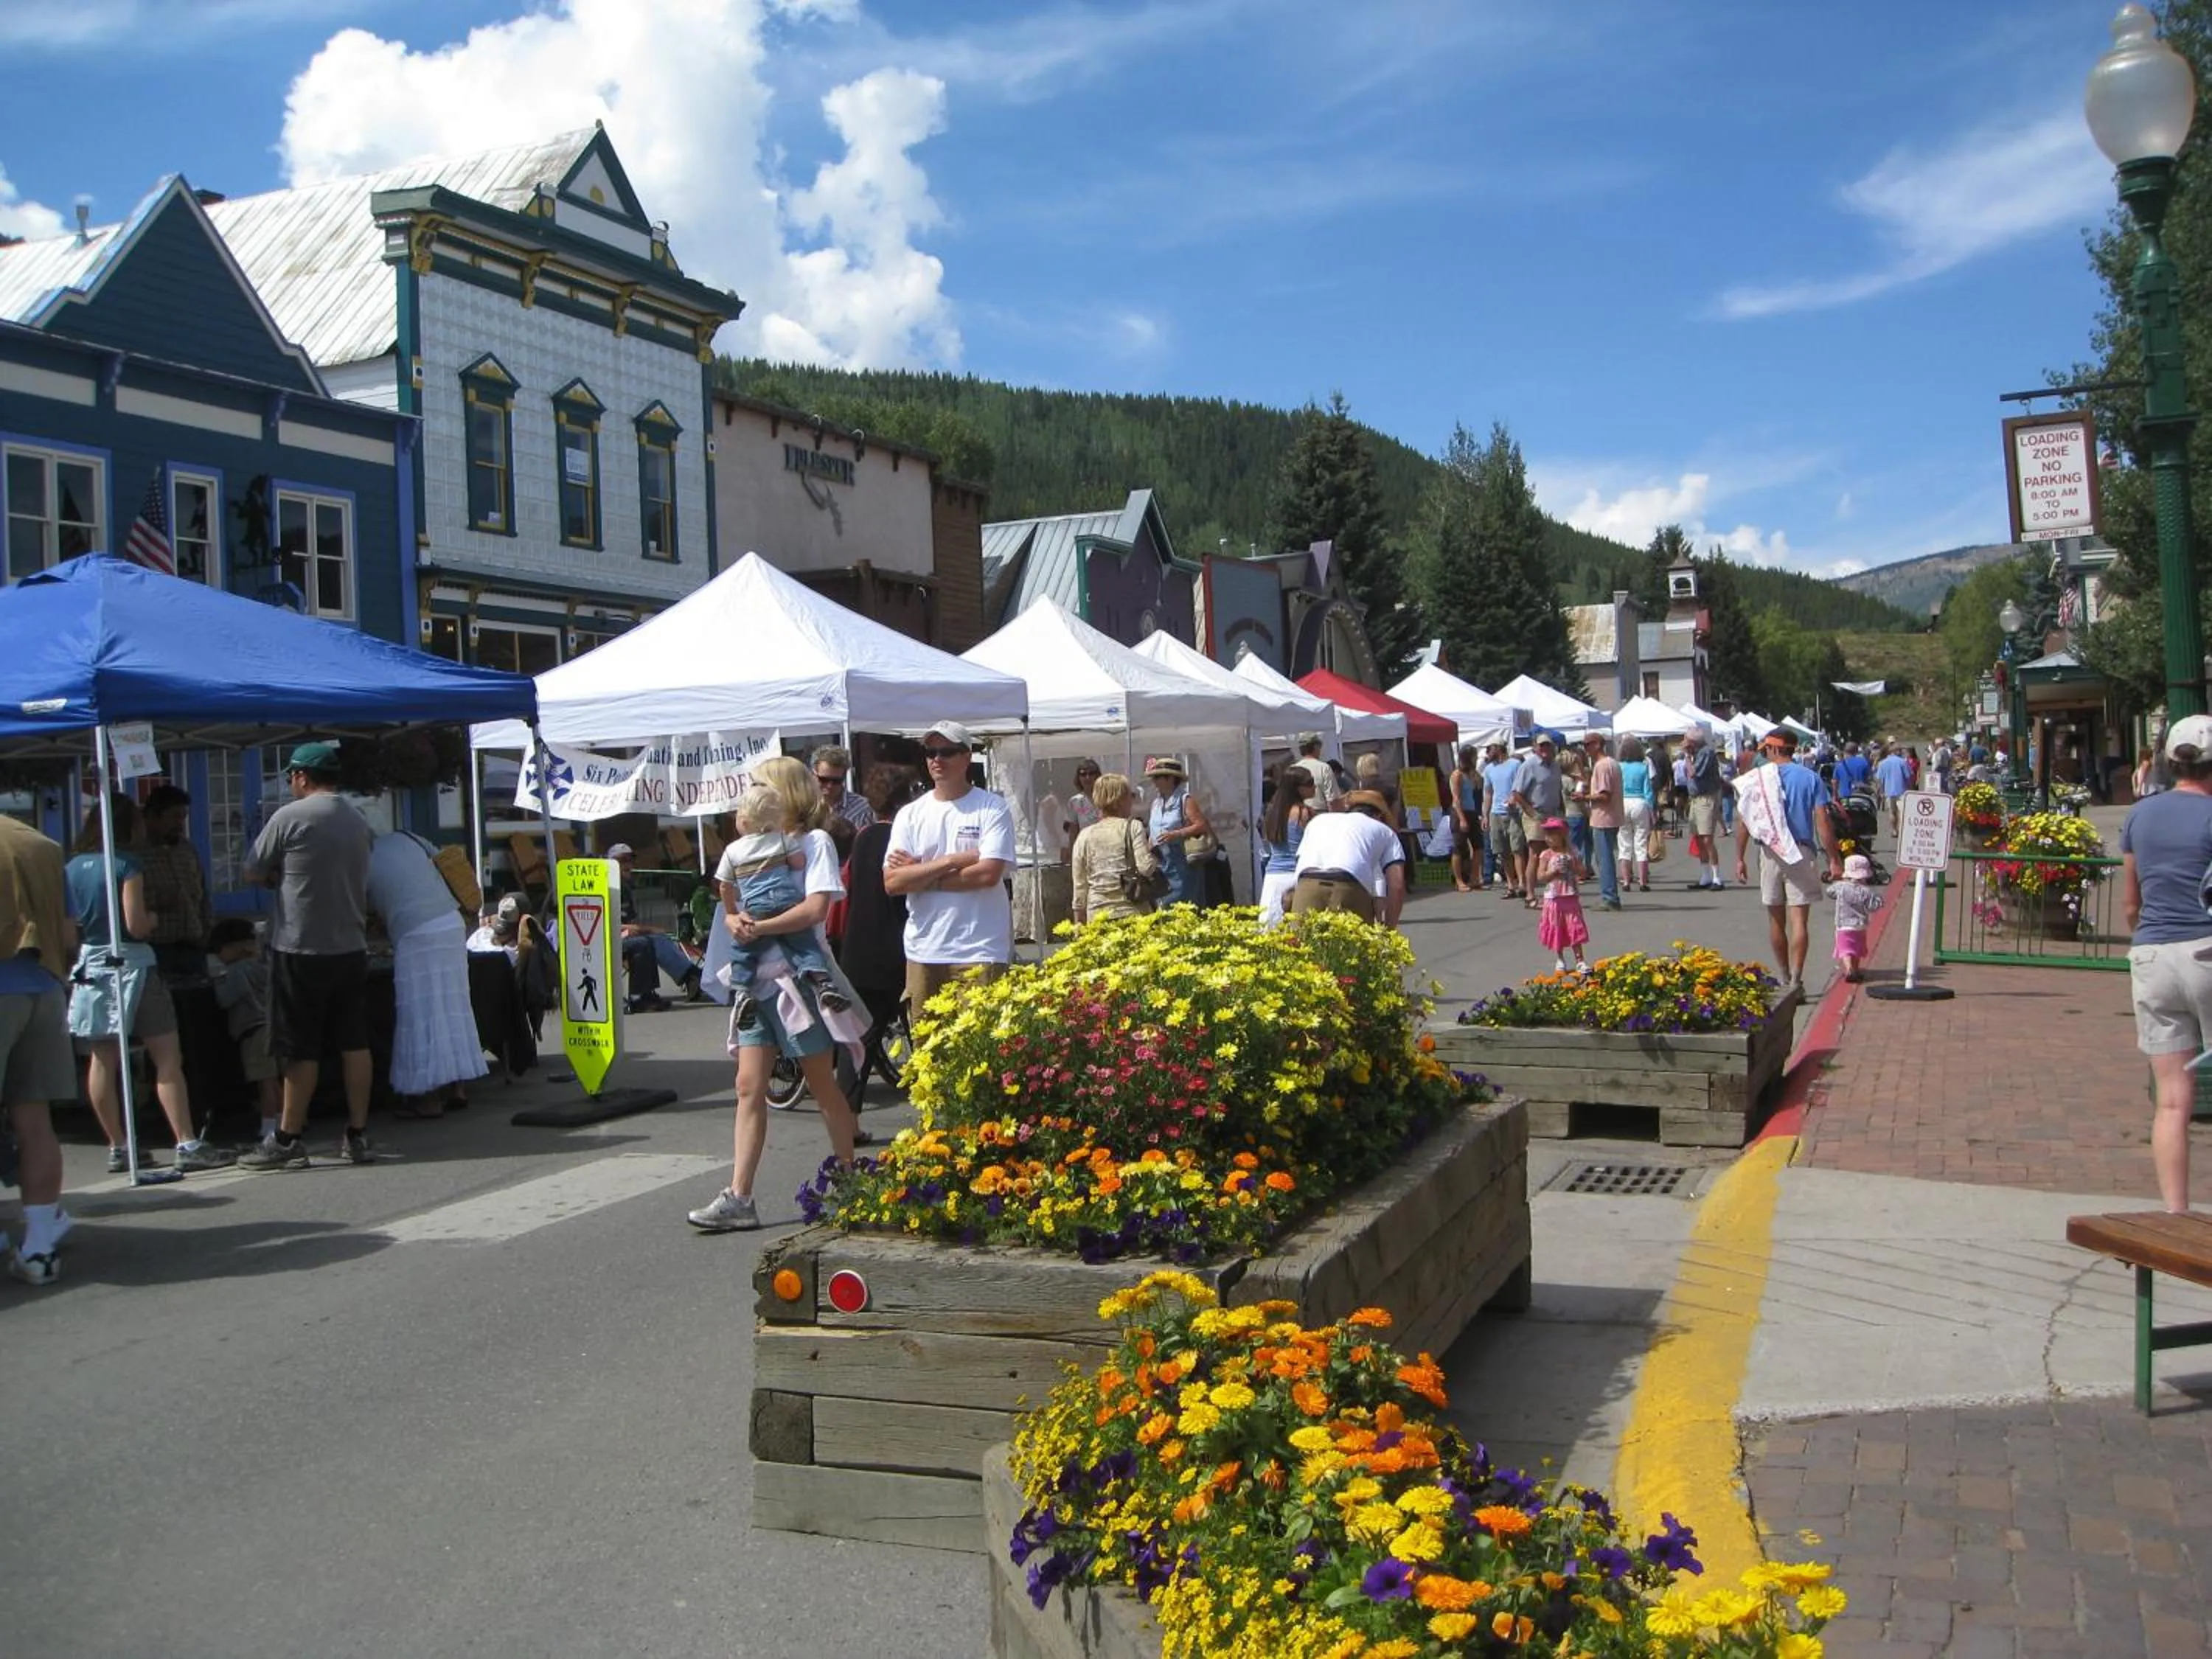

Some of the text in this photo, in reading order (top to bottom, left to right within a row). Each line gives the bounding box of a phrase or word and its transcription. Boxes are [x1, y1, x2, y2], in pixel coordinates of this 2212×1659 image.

[2020, 431, 2079, 447] LOADING
[2032, 445, 2070, 459] ZONE
[2042, 459, 2062, 472] NO
[2024, 472, 2082, 487] PARKING
[2061, 487, 2078, 497] AM
[2045, 499, 2061, 509] TO
[2062, 509, 2079, 518] PM
[584, 764, 603, 783] Six
[678, 746, 700, 768] and
[1907, 816, 1944, 828] LOADING
[1914, 828, 1935, 839] ZONE
[567, 864, 599, 877] STATE
[572, 878, 594, 891] LAW
[568, 1037, 610, 1047] CROSSWALK
